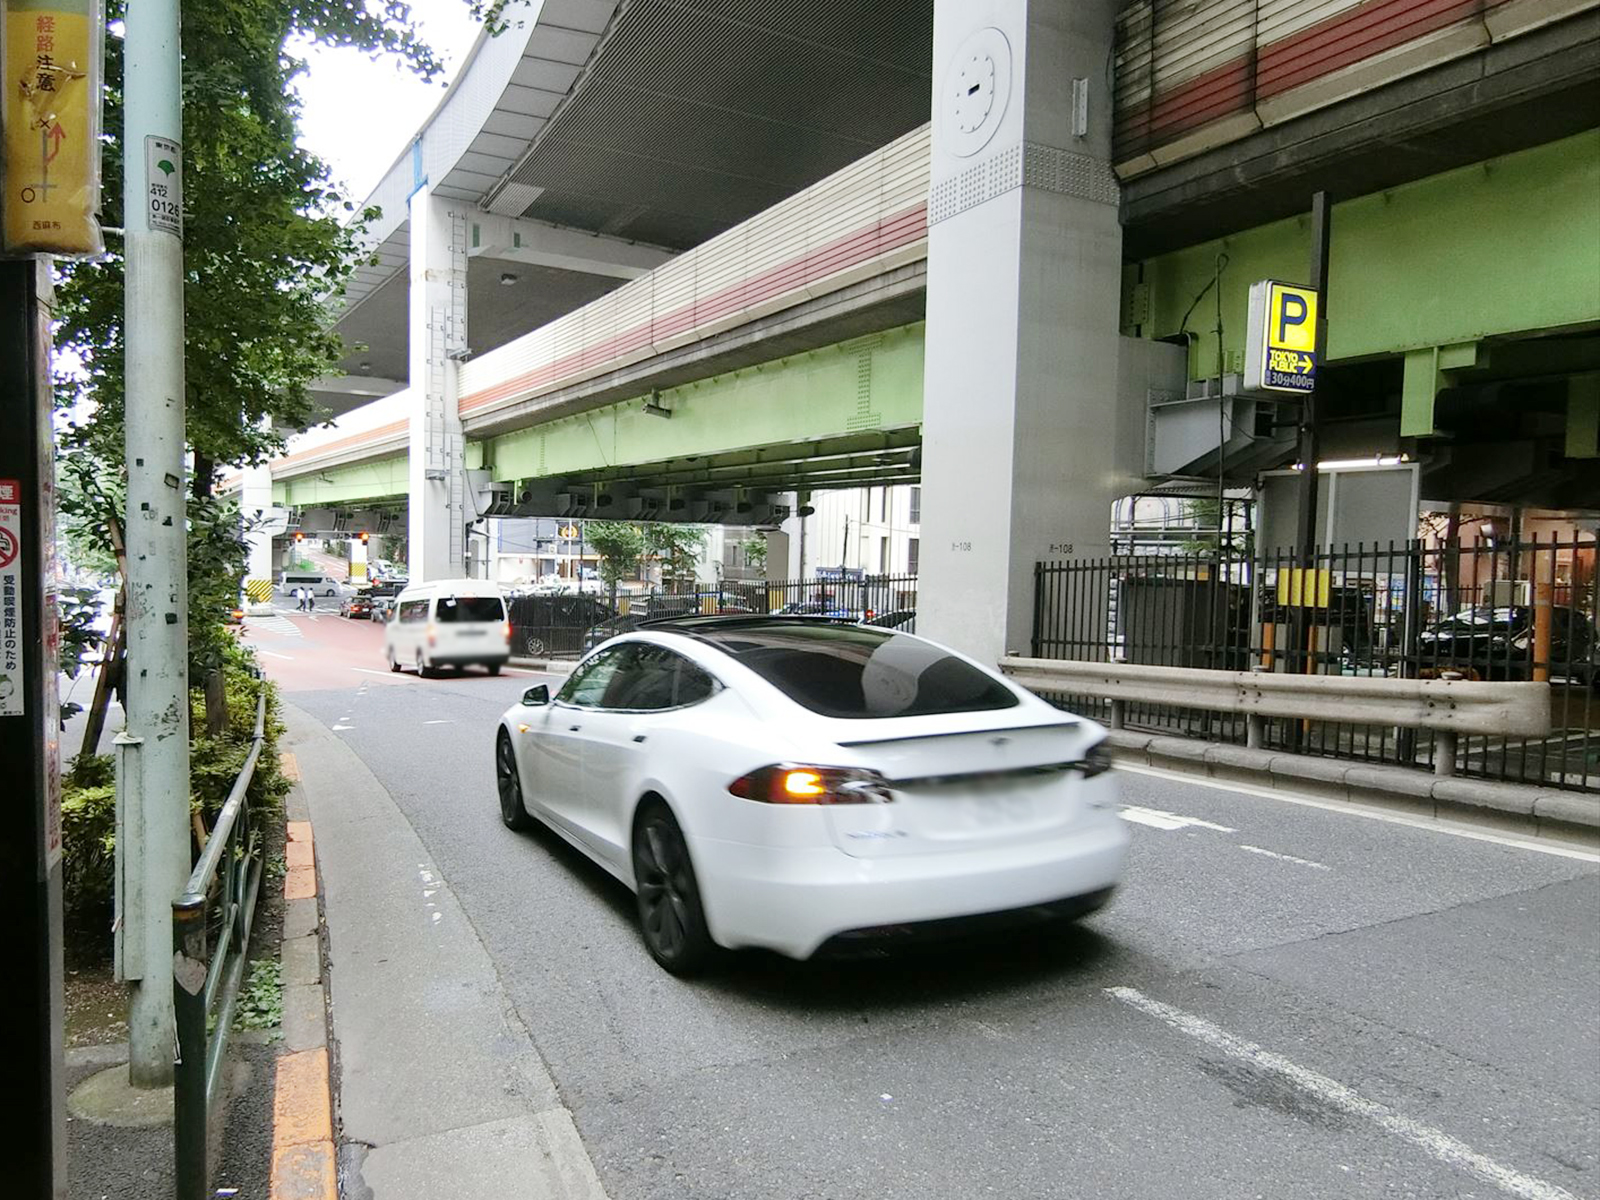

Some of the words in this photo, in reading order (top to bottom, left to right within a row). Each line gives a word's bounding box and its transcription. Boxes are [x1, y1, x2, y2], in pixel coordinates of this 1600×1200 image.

[36, 15, 56, 92] 経路注意
[150, 187, 168, 198] 412
[151, 199, 180, 218] 0126
[32, 220, 62, 231] 西麻布
[1279, 292, 1308, 343] P
[1269, 350, 1298, 362] TOKYO
[1271, 372, 1315, 389] 30分400円
